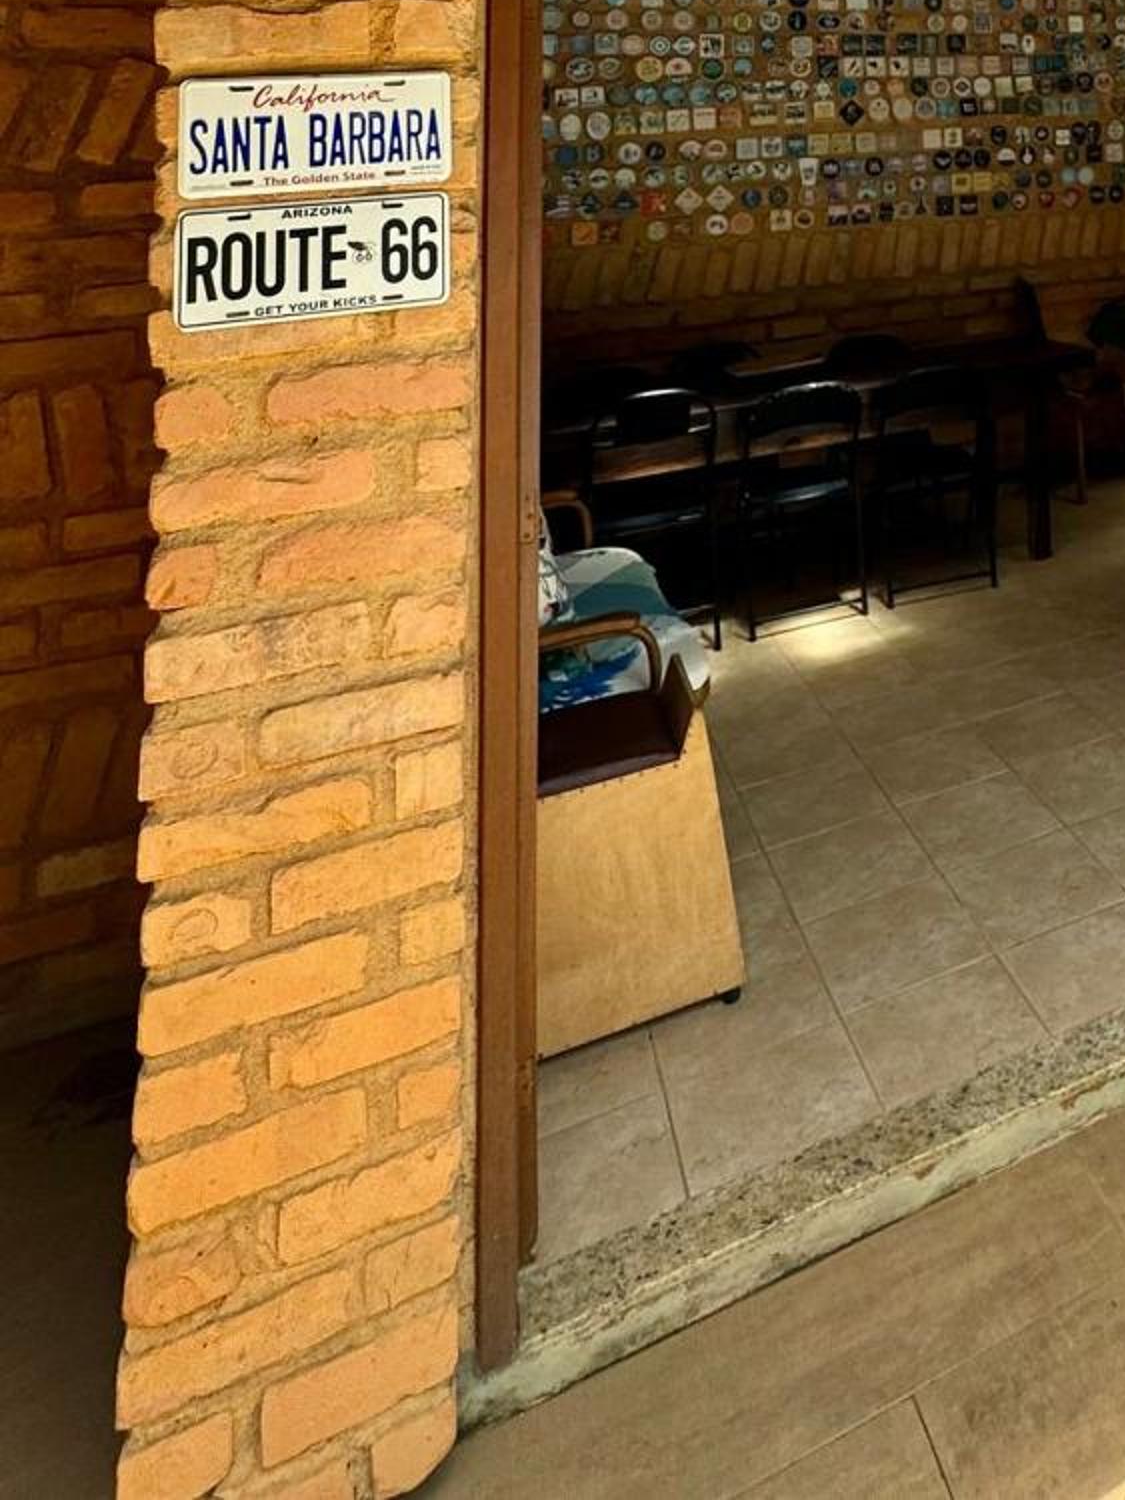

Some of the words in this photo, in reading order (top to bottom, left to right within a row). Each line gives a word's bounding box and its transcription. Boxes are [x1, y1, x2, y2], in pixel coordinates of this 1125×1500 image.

[253, 85, 395, 111] California
[190, 115, 289, 174] SANTA
[309, 108, 441, 167] BARBARA
[264, 177, 288, 186] The
[292, 173, 340, 185] Golden
[342, 171, 375, 181] State
[281, 205, 353, 219] ARIZONA
[186, 225, 346, 304] ROUTE
[382, 216, 437, 284] 66
[254, 306, 282, 317] GET
[289, 301, 328, 313] YOUR
[333, 295, 377, 307] KICKS
